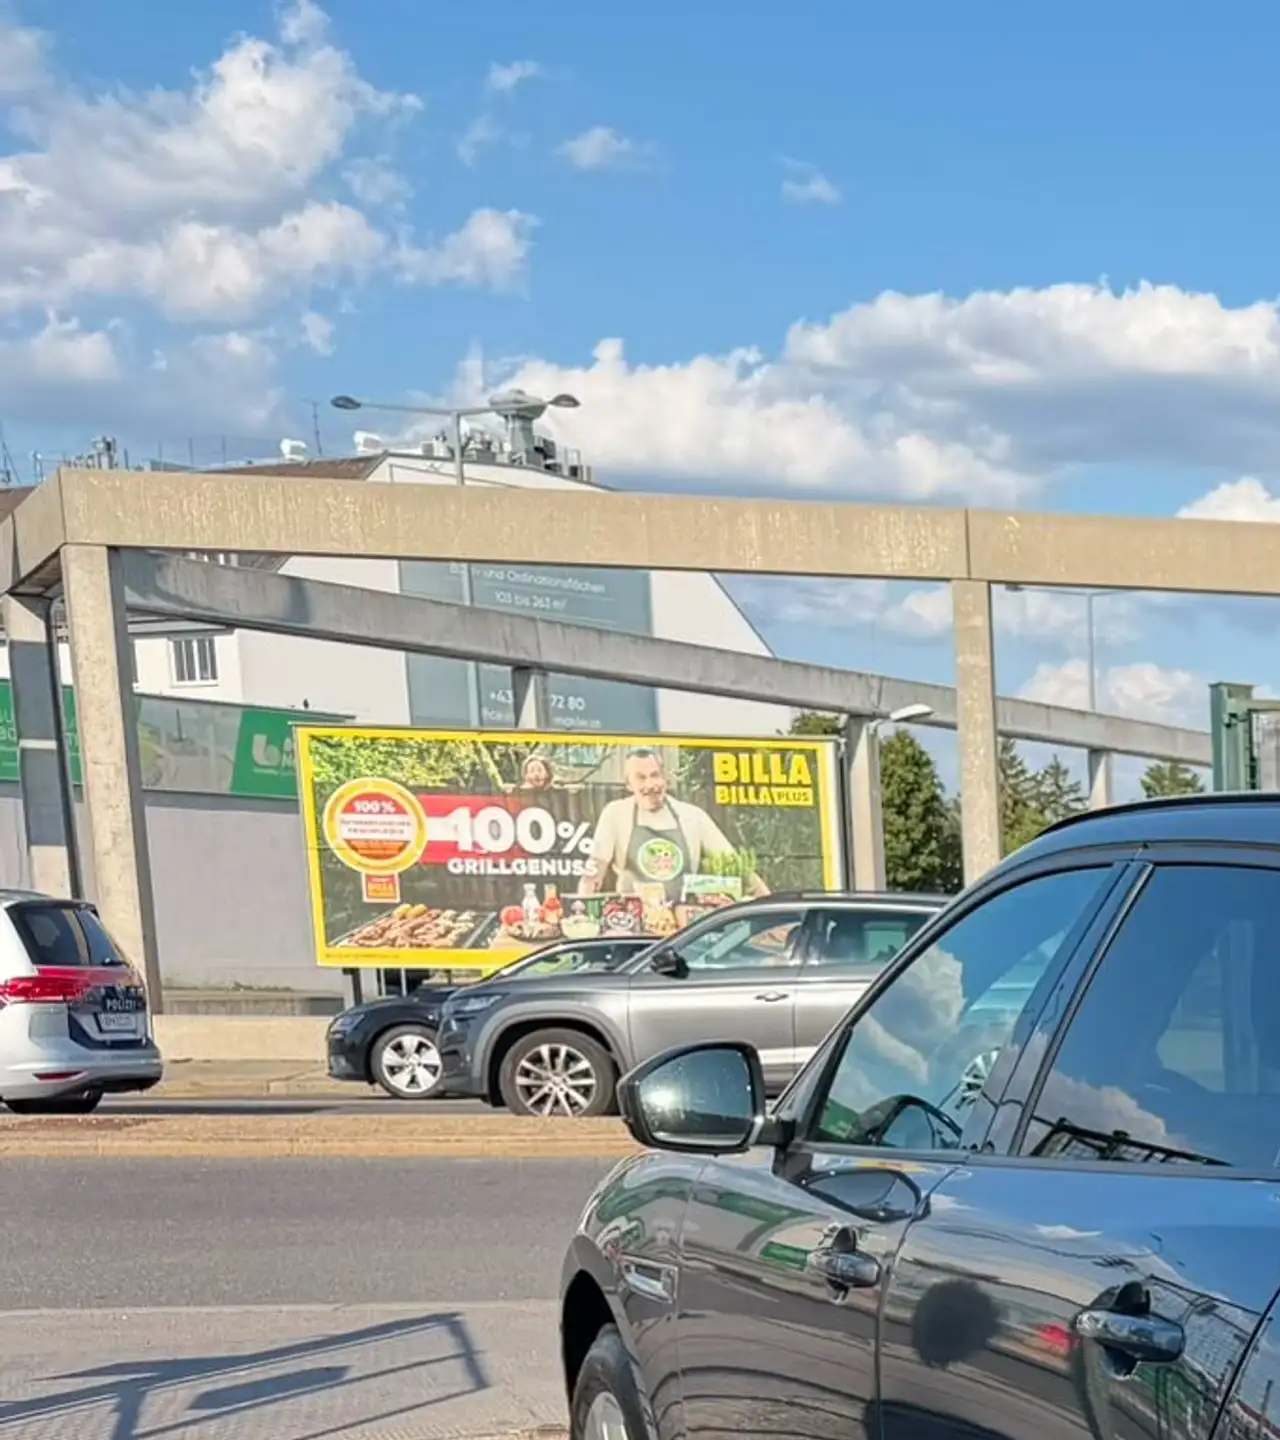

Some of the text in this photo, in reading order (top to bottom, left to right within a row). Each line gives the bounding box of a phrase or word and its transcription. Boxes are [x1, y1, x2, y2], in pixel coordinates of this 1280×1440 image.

[713, 752, 812, 784] BILLA
[715, 785, 810, 805] BILLA PLUS
[449, 806, 597, 854] 100%
[447, 857, 600, 876] GRILLGENUSS
